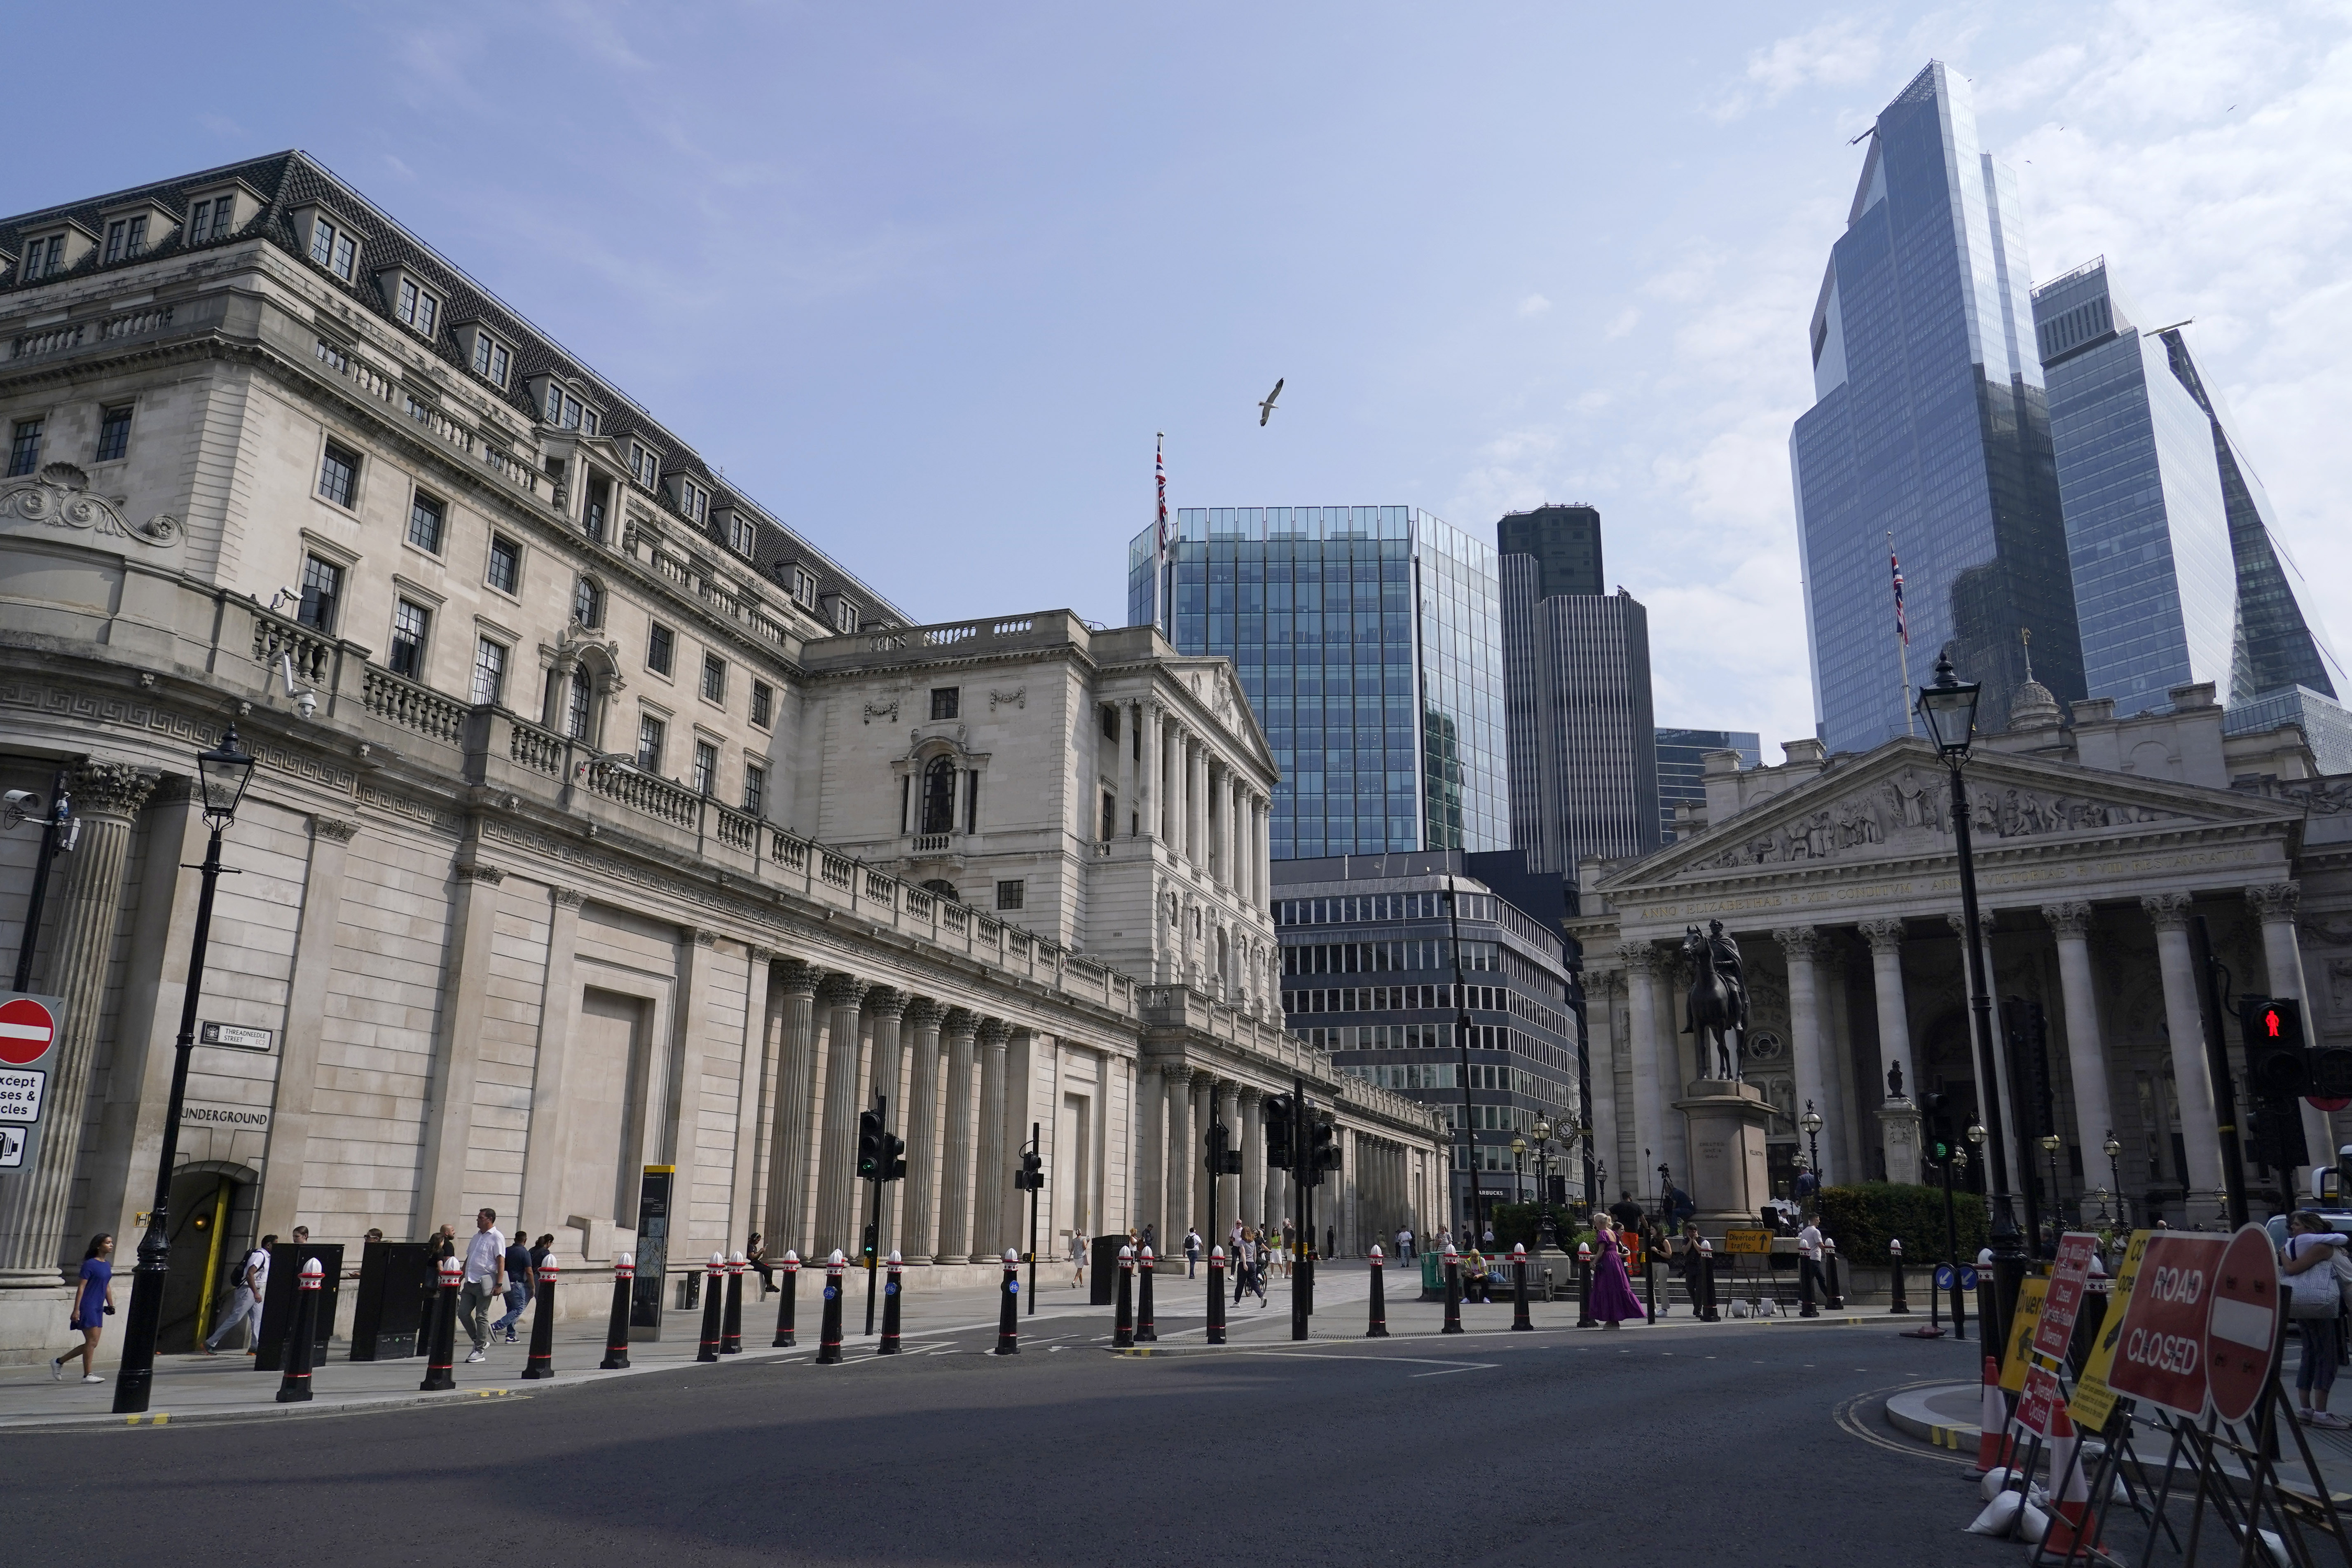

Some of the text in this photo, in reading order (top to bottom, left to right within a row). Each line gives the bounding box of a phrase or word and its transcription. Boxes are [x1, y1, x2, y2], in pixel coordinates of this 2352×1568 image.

[1641, 849, 2256, 919] ANNO ELIZABETHAE R XIII CONDITVM ANN VICTORIAE R VIII RESTAVRATVM
[225, 1028, 266, 1039] THREADNEEDLE
[0, 1077, 36, 1088] xcept
[0, 1091, 35, 1101] ses &
[0, 1103, 28, 1115] cles
[181, 1107, 267, 1125] UNDERGROUND
[2131, 1239, 2146, 1261] CC
[2056, 1285, 2073, 1303] Closed
[2118, 1275, 2134, 1297] ope
[2151, 1266, 2203, 1305] ROAD
[2127, 1327, 2198, 1376] CLOSED
[2034, 1378, 2054, 1402] Diverted
[2029, 1400, 2046, 1424] Cyclists
